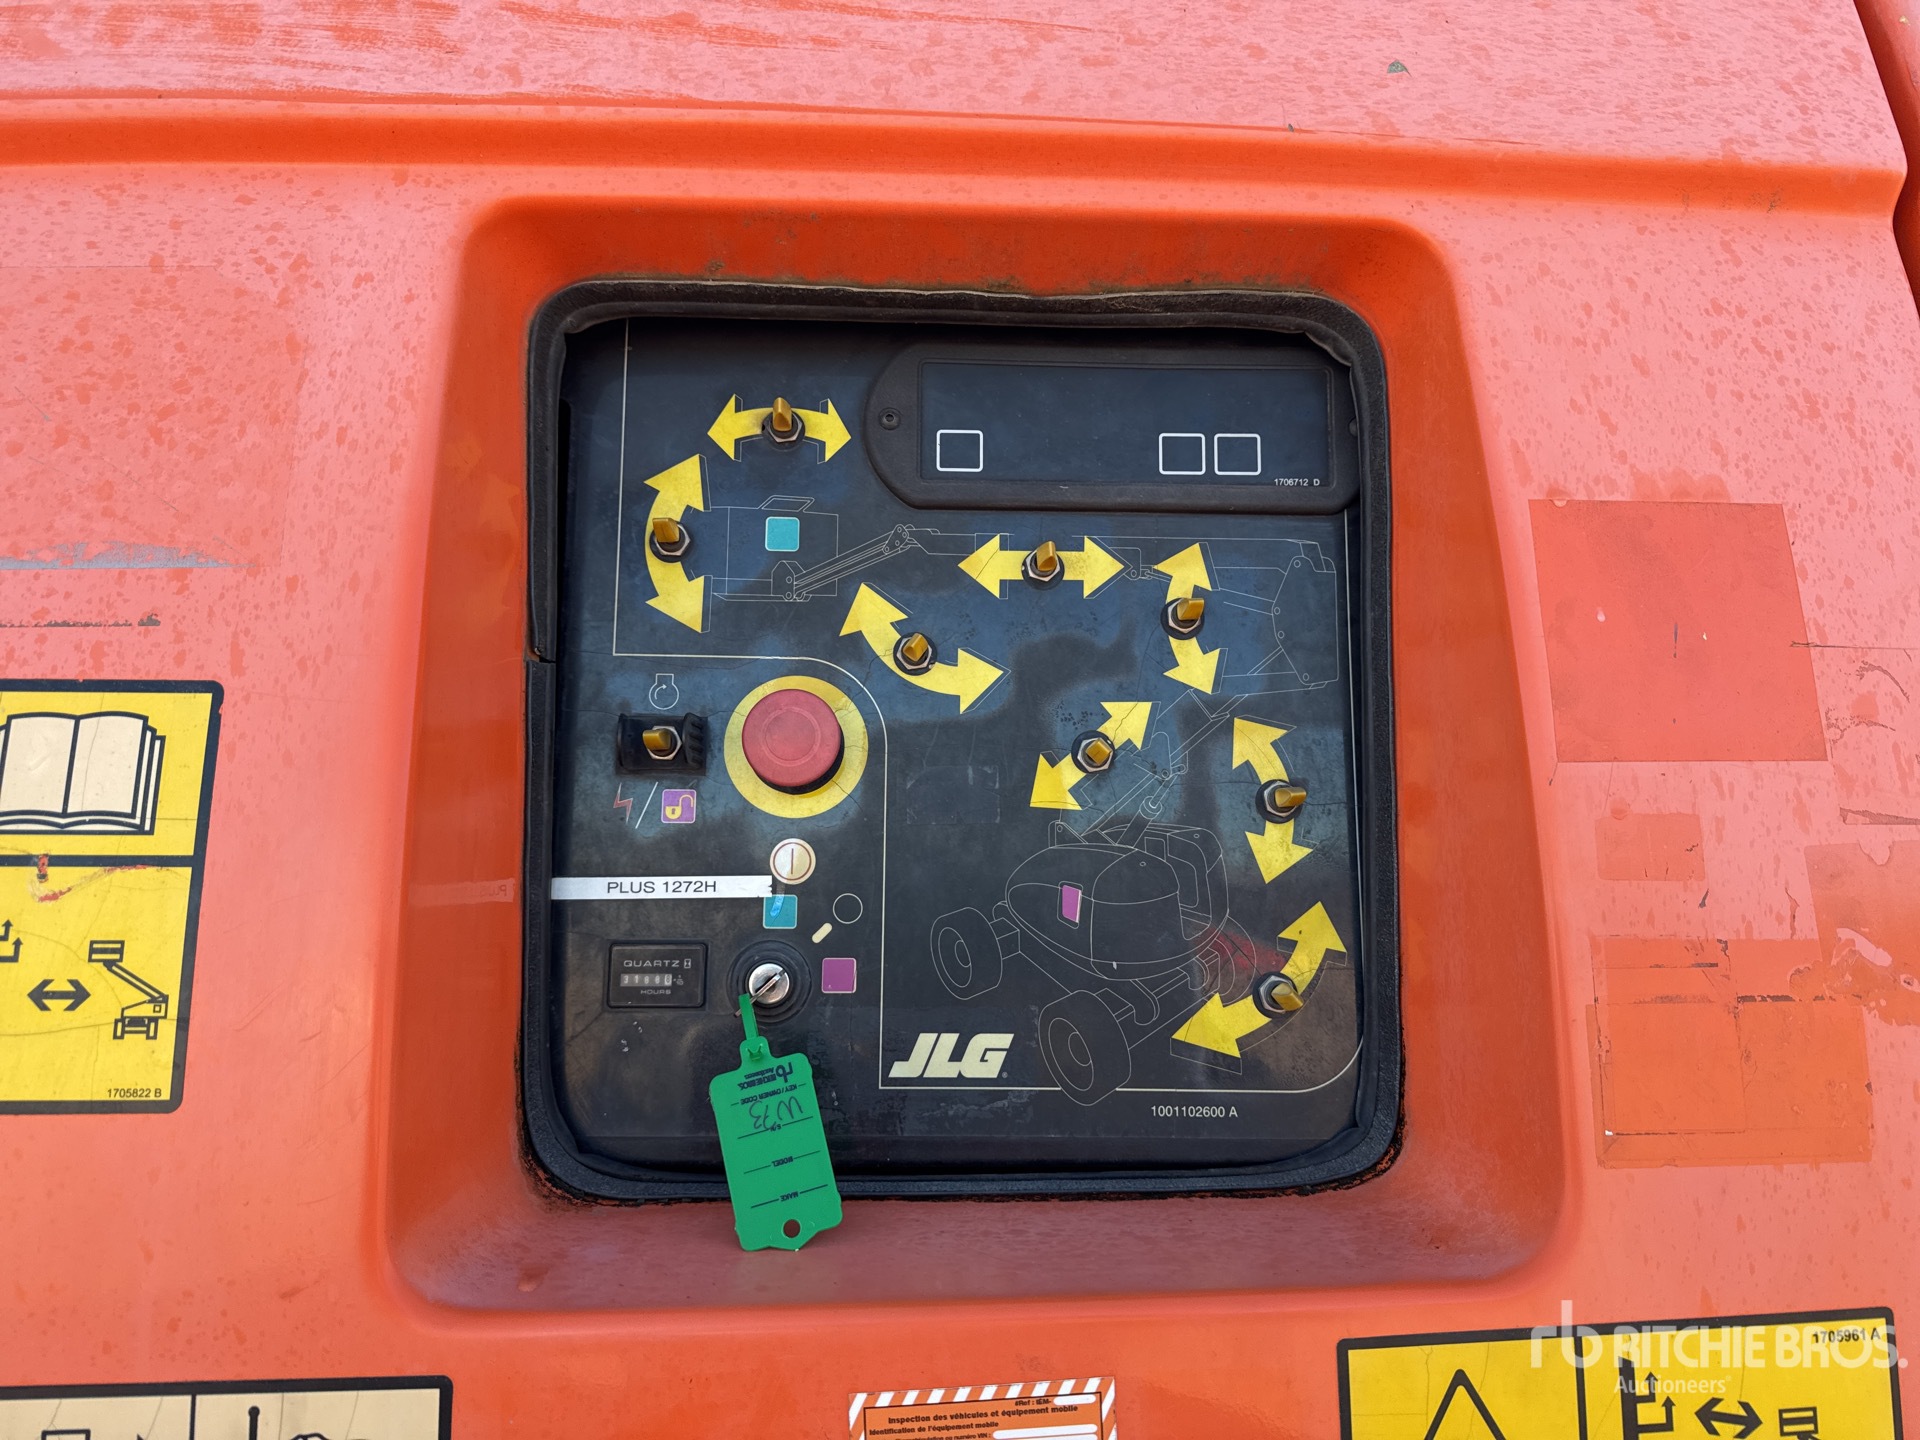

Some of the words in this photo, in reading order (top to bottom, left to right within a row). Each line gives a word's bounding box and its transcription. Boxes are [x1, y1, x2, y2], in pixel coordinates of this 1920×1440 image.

[1274, 478, 1308, 486] 1706712
[1313, 478, 1320, 486] D
[607, 881, 656, 894] PLUS
[662, 880, 717, 893] 1272H
[623, 959, 680, 967] QUARTZ
[888, 1032, 1014, 1078] JLG
[107, 1088, 152, 1098] 1705822
[154, 1088, 162, 1098] B
[1151, 1105, 1226, 1118] 1001102600
[1229, 1106, 1239, 1118] A
[1812, 1328, 1867, 1344] 1705961
[1870, 1327, 1881, 1341] A
[888, 1415, 931, 1424] Inspection
[933, 1413, 948, 1421] des
[950, 1411, 988, 1420] véhicules
[1001, 1406, 1049, 1417] équipement
[1051, 1405, 1078, 1413] mobile
[869, 1427, 916, 1435] Identification
[975, 1421, 999, 1429] mobile
